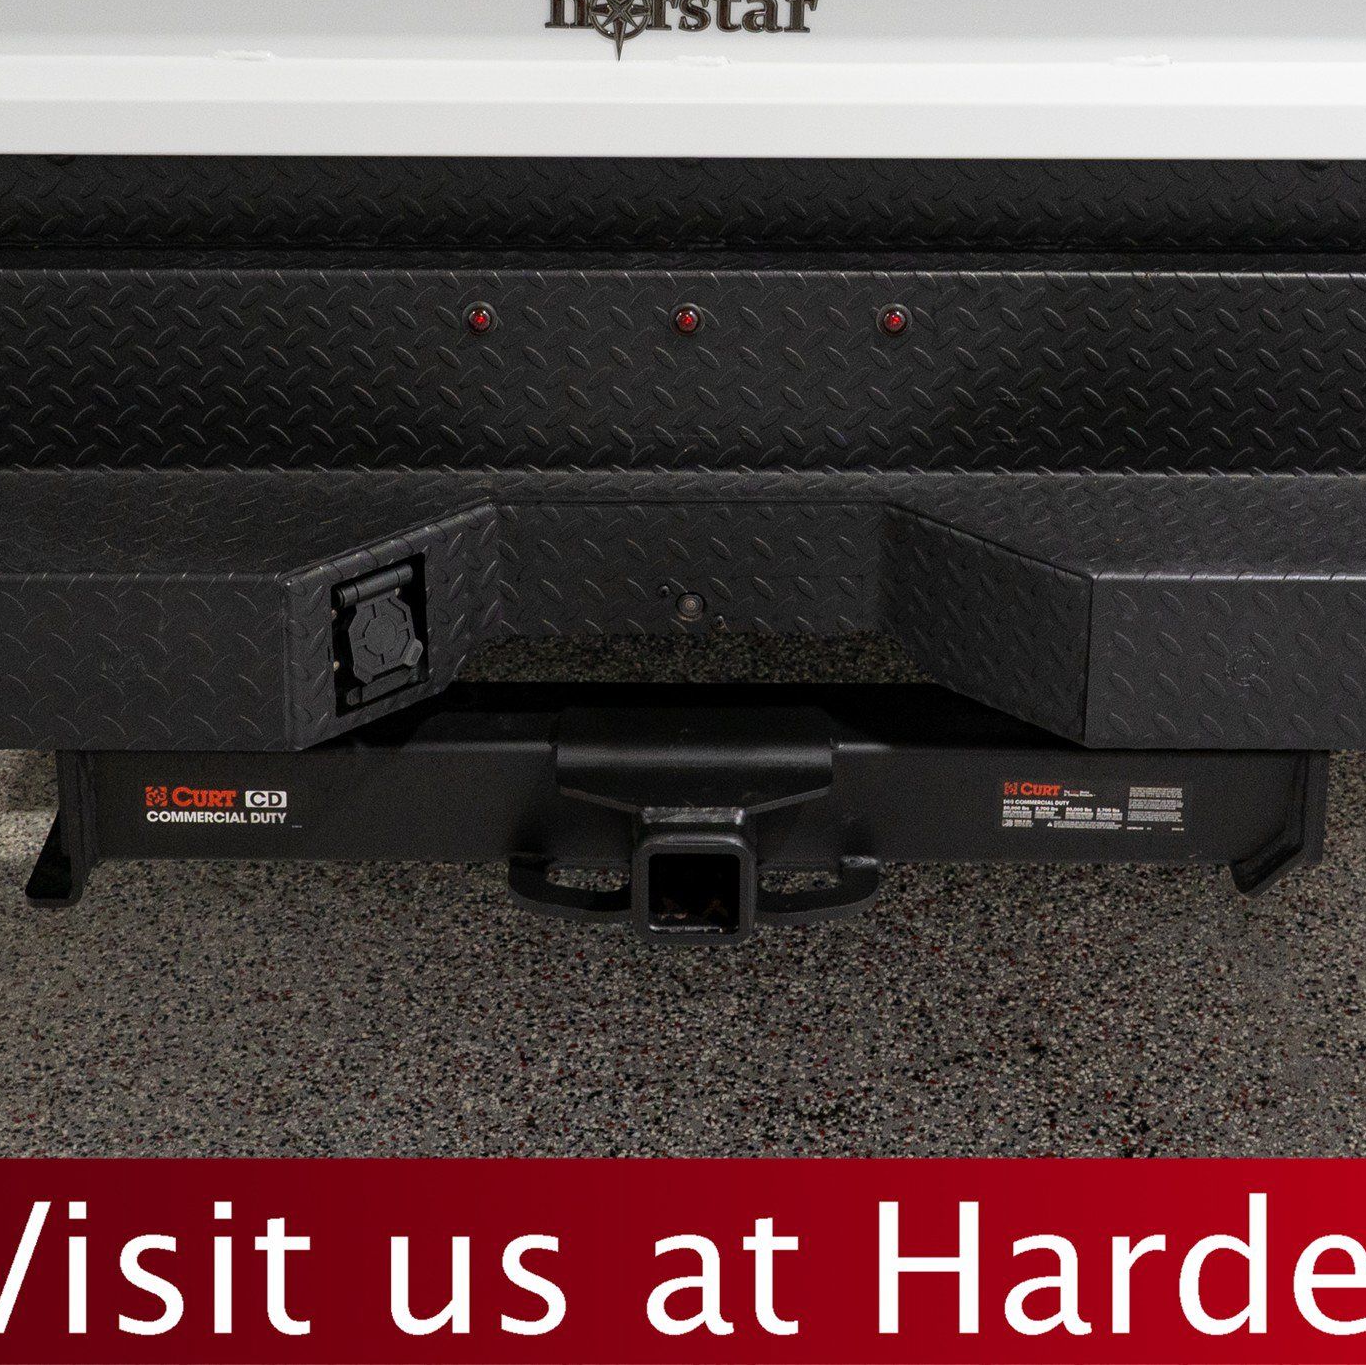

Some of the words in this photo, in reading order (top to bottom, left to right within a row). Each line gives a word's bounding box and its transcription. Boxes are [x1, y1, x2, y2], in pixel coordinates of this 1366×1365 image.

[1020, 782, 1060, 796] CURT
[172, 786, 237, 807] CURT
[249, 791, 283, 807] CD
[146, 810, 247, 823] COMMERCIAL
[250, 811, 287, 824] DUTY
